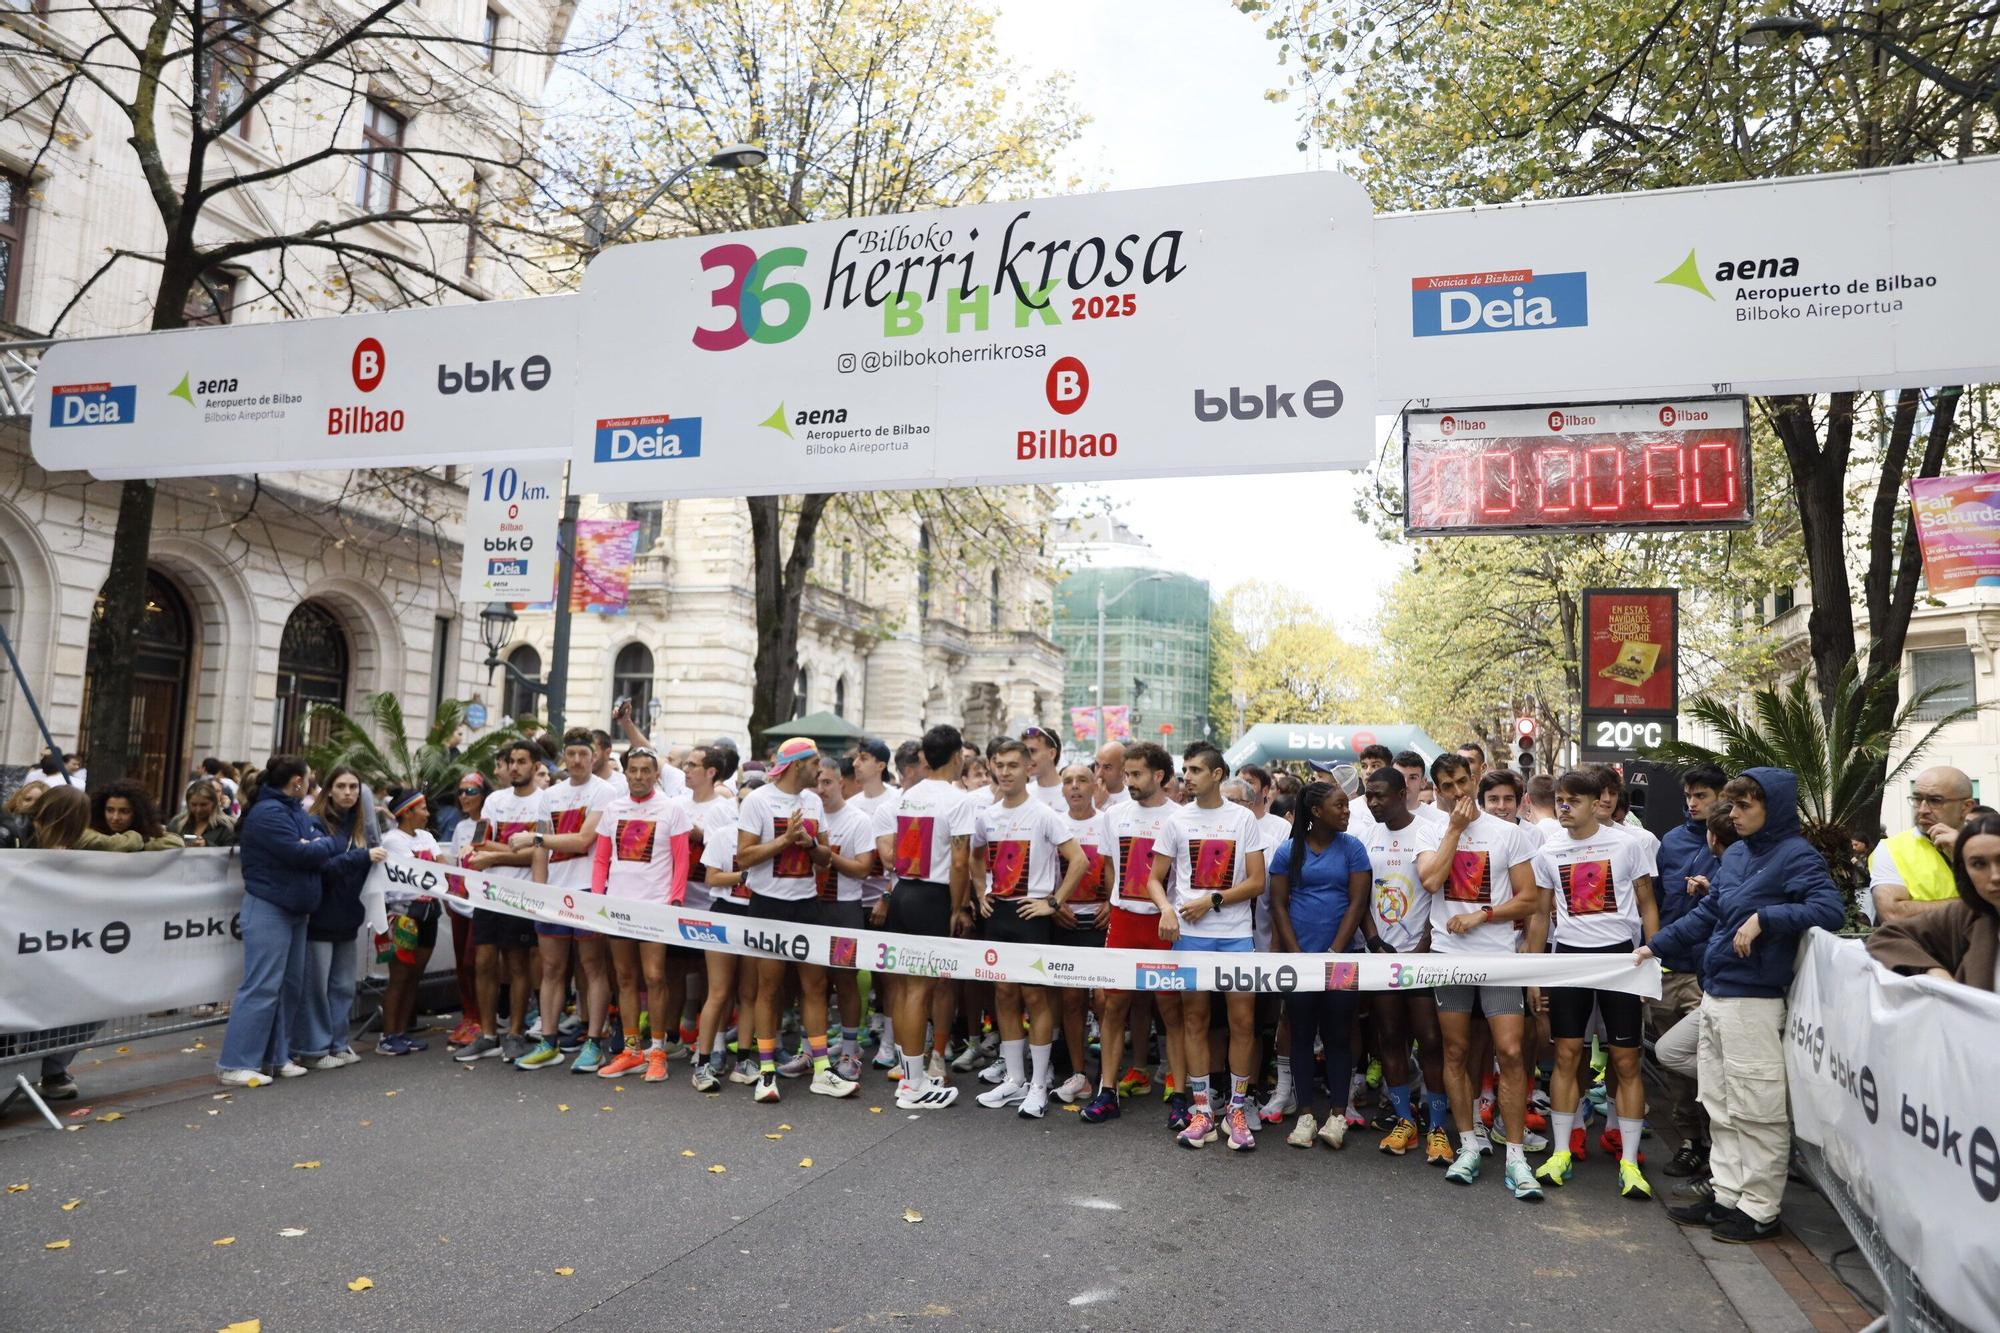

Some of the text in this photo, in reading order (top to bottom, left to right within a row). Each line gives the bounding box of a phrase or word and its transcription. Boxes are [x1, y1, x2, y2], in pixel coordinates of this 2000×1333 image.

[859, 222, 953, 254] Bilboko
[1715, 256, 1799, 281] aena
[691, 211, 1187, 352] 36 herri krosa
[1428, 273, 1524, 288] Noticias de Bizkaia
[1735, 274, 1937, 301] Aeropuerto de Bilbao
[1071, 293, 1137, 321] 2025
[1440, 287, 1557, 331] Deia
[1736, 299, 1903, 321] Bilboko Aireportua
[861, 342, 1047, 373] @bilbokoherrikrosa
[197, 378, 239, 394] aena
[438, 360, 515, 395] bbk
[63, 394, 120, 424] Deia
[206, 394, 302, 410] Aeropuerto de Bilbao
[1194, 384, 1298, 422] bbk
[204, 410, 285, 423] Bilboko Aireportua
[328, 407, 404, 435] Bilbao
[606, 418, 631, 428] Noticias
[631, 417, 639, 426] de
[795, 408, 847, 425] aena
[1441, 417, 1486, 433] Bilbao
[1550, 413, 1596, 430] Bilbao
[1661, 408, 1708, 425] Bilbao
[610, 427, 681, 459] Deia
[806, 424, 930, 441] Aeropuerto de Bilbao
[806, 440, 909, 455] Bilboko Aireportua
[1017, 429, 1117, 460] Bilbao
[482, 467, 550, 501] 10 km.
[1916, 495, 1954, 512] Fair
[500, 523, 523, 531] Bilbao
[484, 537, 517, 551] bbk
[494, 562, 520, 575] Deia
[1612, 605, 1648, 614] EN ESTAS
[1641, 623, 1651, 632] DE
[1288, 731, 1346, 750] bbk
[1597, 721, 1662, 748] 20°C
[384, 861, 419, 888] bbk
[611, 911, 631, 921] aena
[164, 917, 225, 940] bbk
[686, 926, 719, 942] Deia
[18, 928, 93, 954] bbk
[876, 943, 958, 972] 36 herri krosa
[1048, 961, 1074, 972] aena
[975, 968, 1006, 981] Bilbao
[1145, 970, 1186, 989] Deia
[1214, 966, 1273, 992] bbk
[1388, 963, 1487, 988] 36 herri krosa
[1791, 1012, 1813, 1054] bbk
[1830, 1046, 1858, 1099] bbk
[1901, 1093, 1962, 1167] bbk
